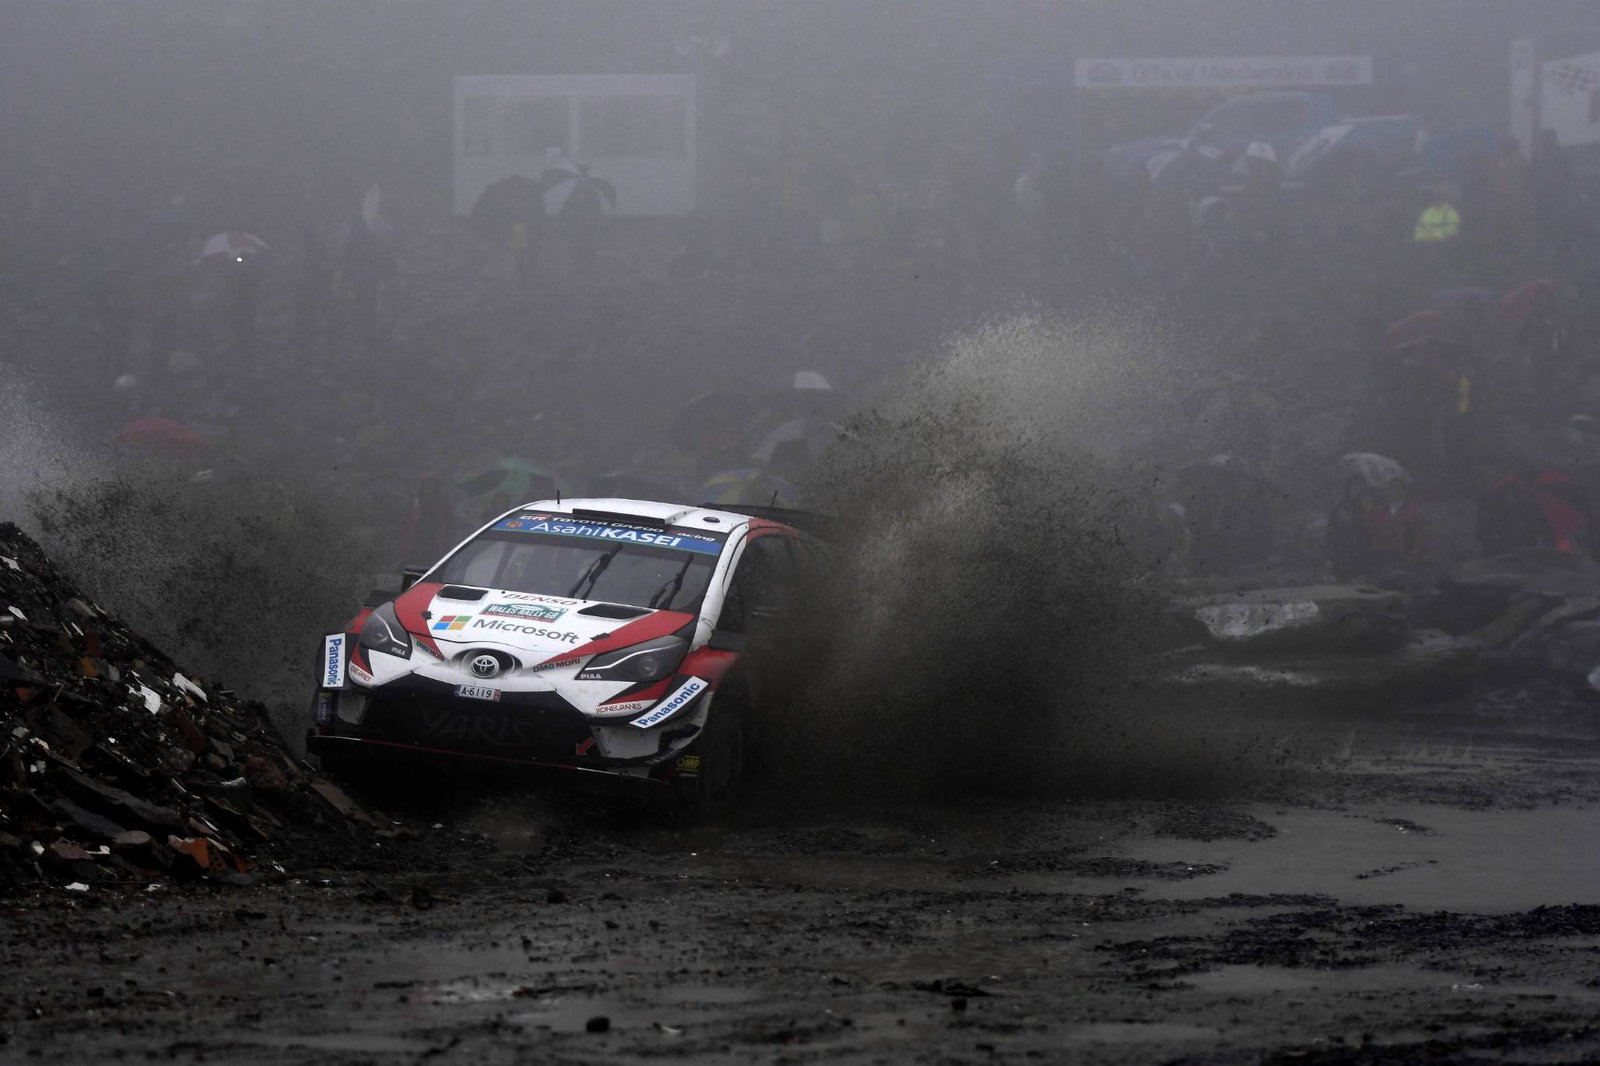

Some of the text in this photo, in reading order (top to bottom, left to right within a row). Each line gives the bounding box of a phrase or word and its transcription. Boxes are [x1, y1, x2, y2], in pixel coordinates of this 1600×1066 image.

[503, 594, 577, 606] DENSO
[488, 603, 518, 616] WALES
[517, 608, 545, 618] RALLY
[473, 619, 580, 644] Microsoft
[327, 638, 342, 685] Panasonic
[533, 658, 581, 673] DMG MORI
[460, 686, 493, 699] A-6119
[637, 682, 701, 726] Panasonic
[676, 757, 701, 770] OMP
